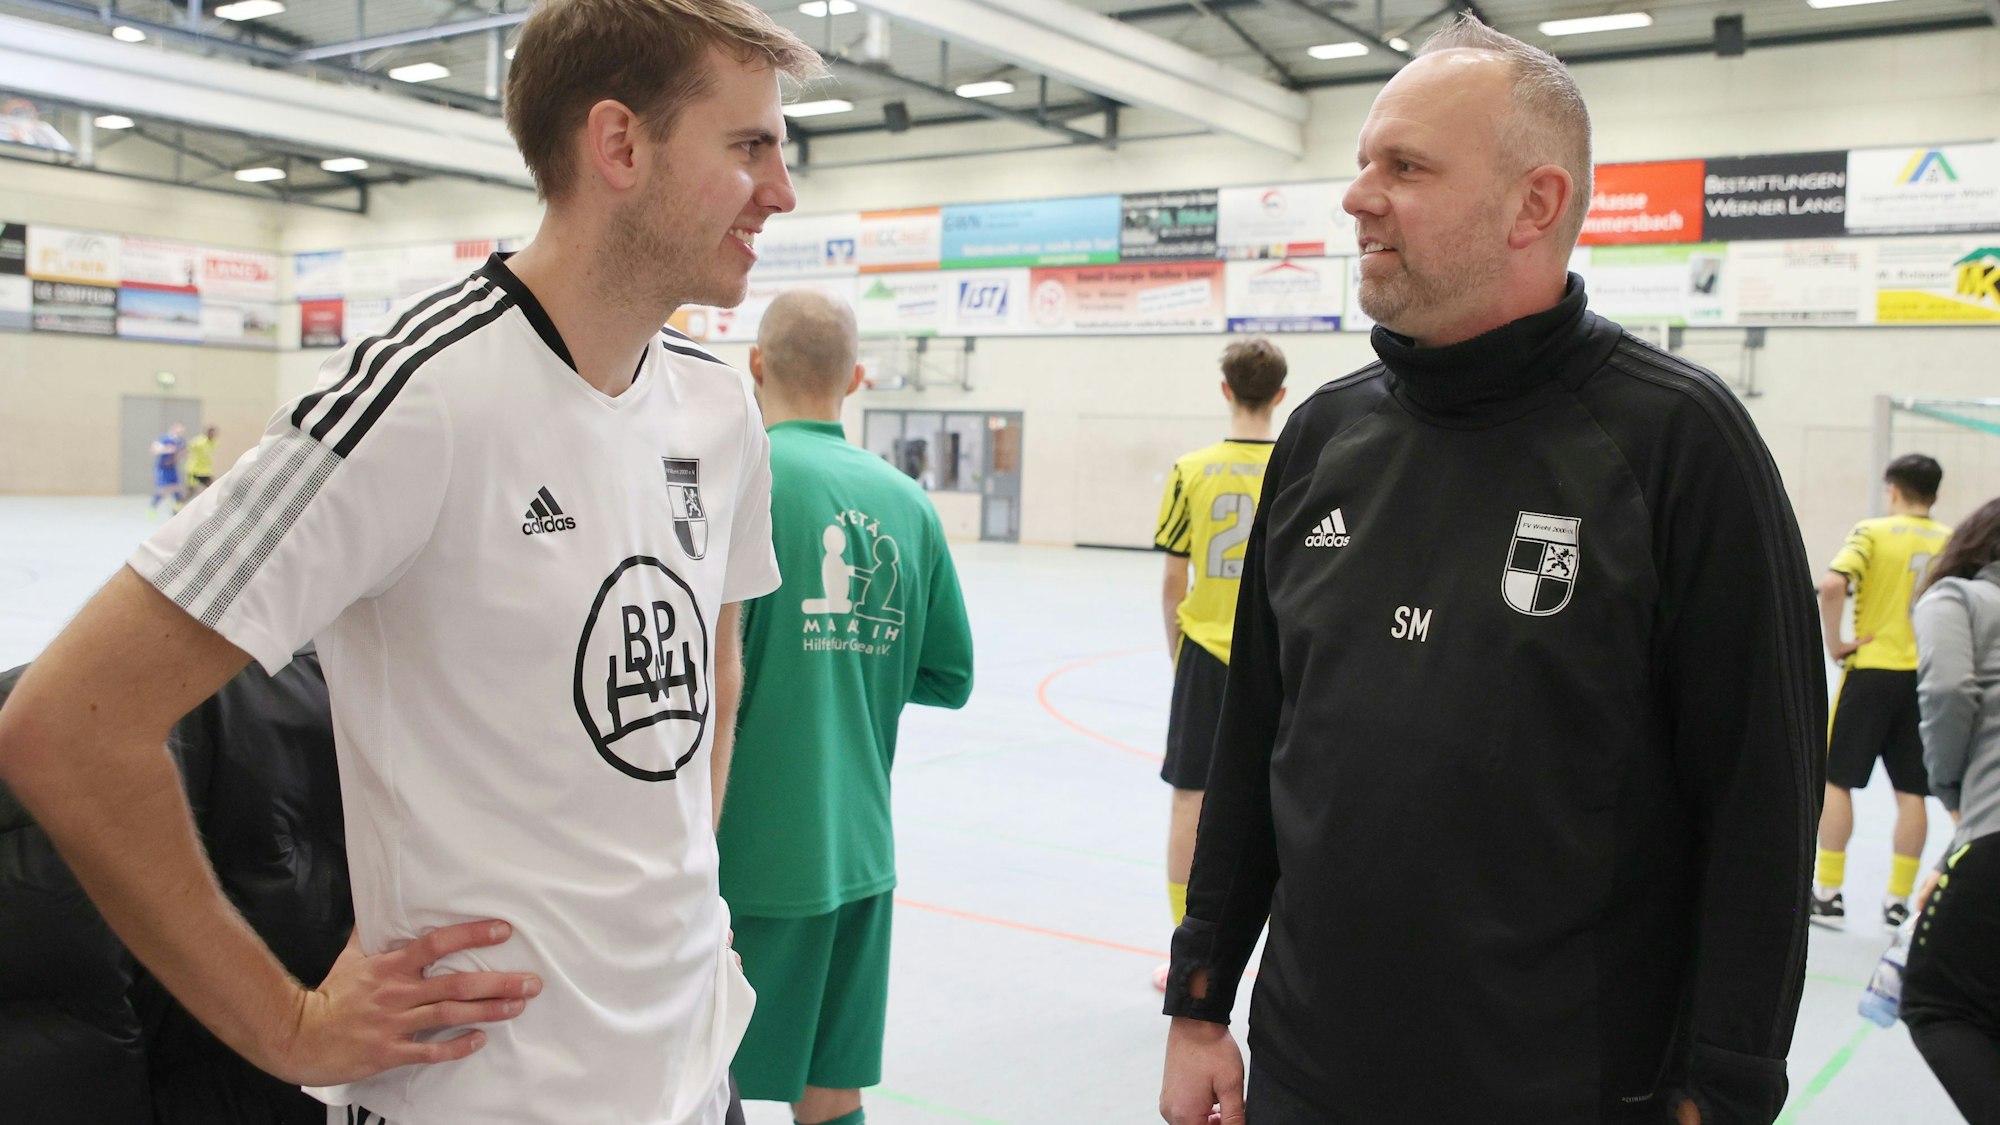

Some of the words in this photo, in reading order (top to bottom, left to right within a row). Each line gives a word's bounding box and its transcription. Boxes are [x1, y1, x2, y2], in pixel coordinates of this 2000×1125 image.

[1705, 172, 1846, 195] BESTATTUNGEN
[1590, 191, 1648, 211] rkasse
[1705, 197, 1787, 218] WERNER
[1788, 194, 1846, 215] LANG
[1580, 210, 1684, 233] mmersbach
[522, 515, 576, 535] adidas
[835, 510, 881, 538] YETÄ
[1206, 493, 1254, 579] 2
[1305, 532, 1350, 547] adidas
[1391, 606, 1432, 642] SM
